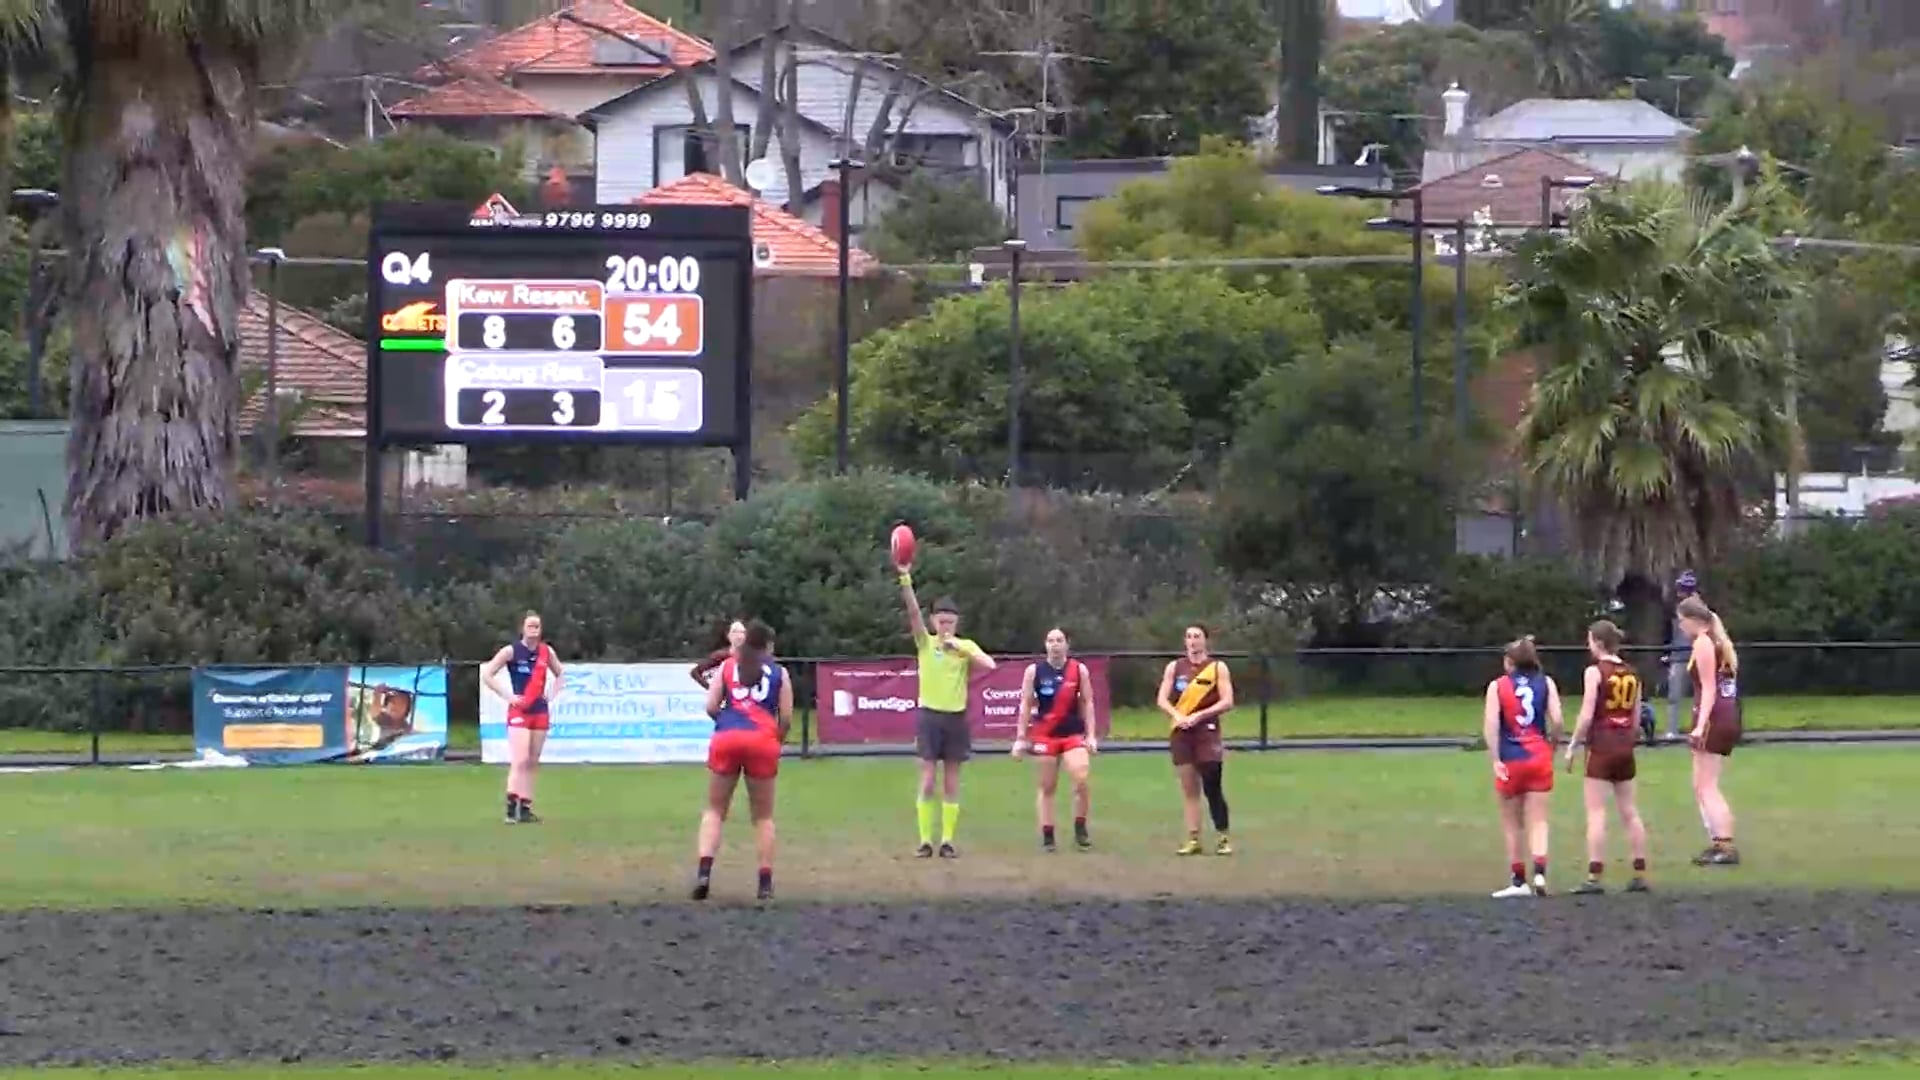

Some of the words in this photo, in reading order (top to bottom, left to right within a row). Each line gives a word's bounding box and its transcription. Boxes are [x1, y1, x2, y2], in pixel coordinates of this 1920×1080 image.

[545, 213, 595, 228] 9796
[601, 213, 651, 228] 9999
[382, 252, 432, 284] Q4
[606, 256, 700, 291] 20:00
[460, 284, 508, 304] Kew
[483, 315, 506, 348] 8
[552, 315, 576, 349] 6
[623, 303, 683, 345] 54
[482, 390, 506, 424] 2
[552, 391, 575, 424] 3
[624, 379, 681, 420] 15
[858, 696, 915, 712] Bendigo
[1515, 686, 1535, 725] 3
[1607, 675, 1637, 709] 30
